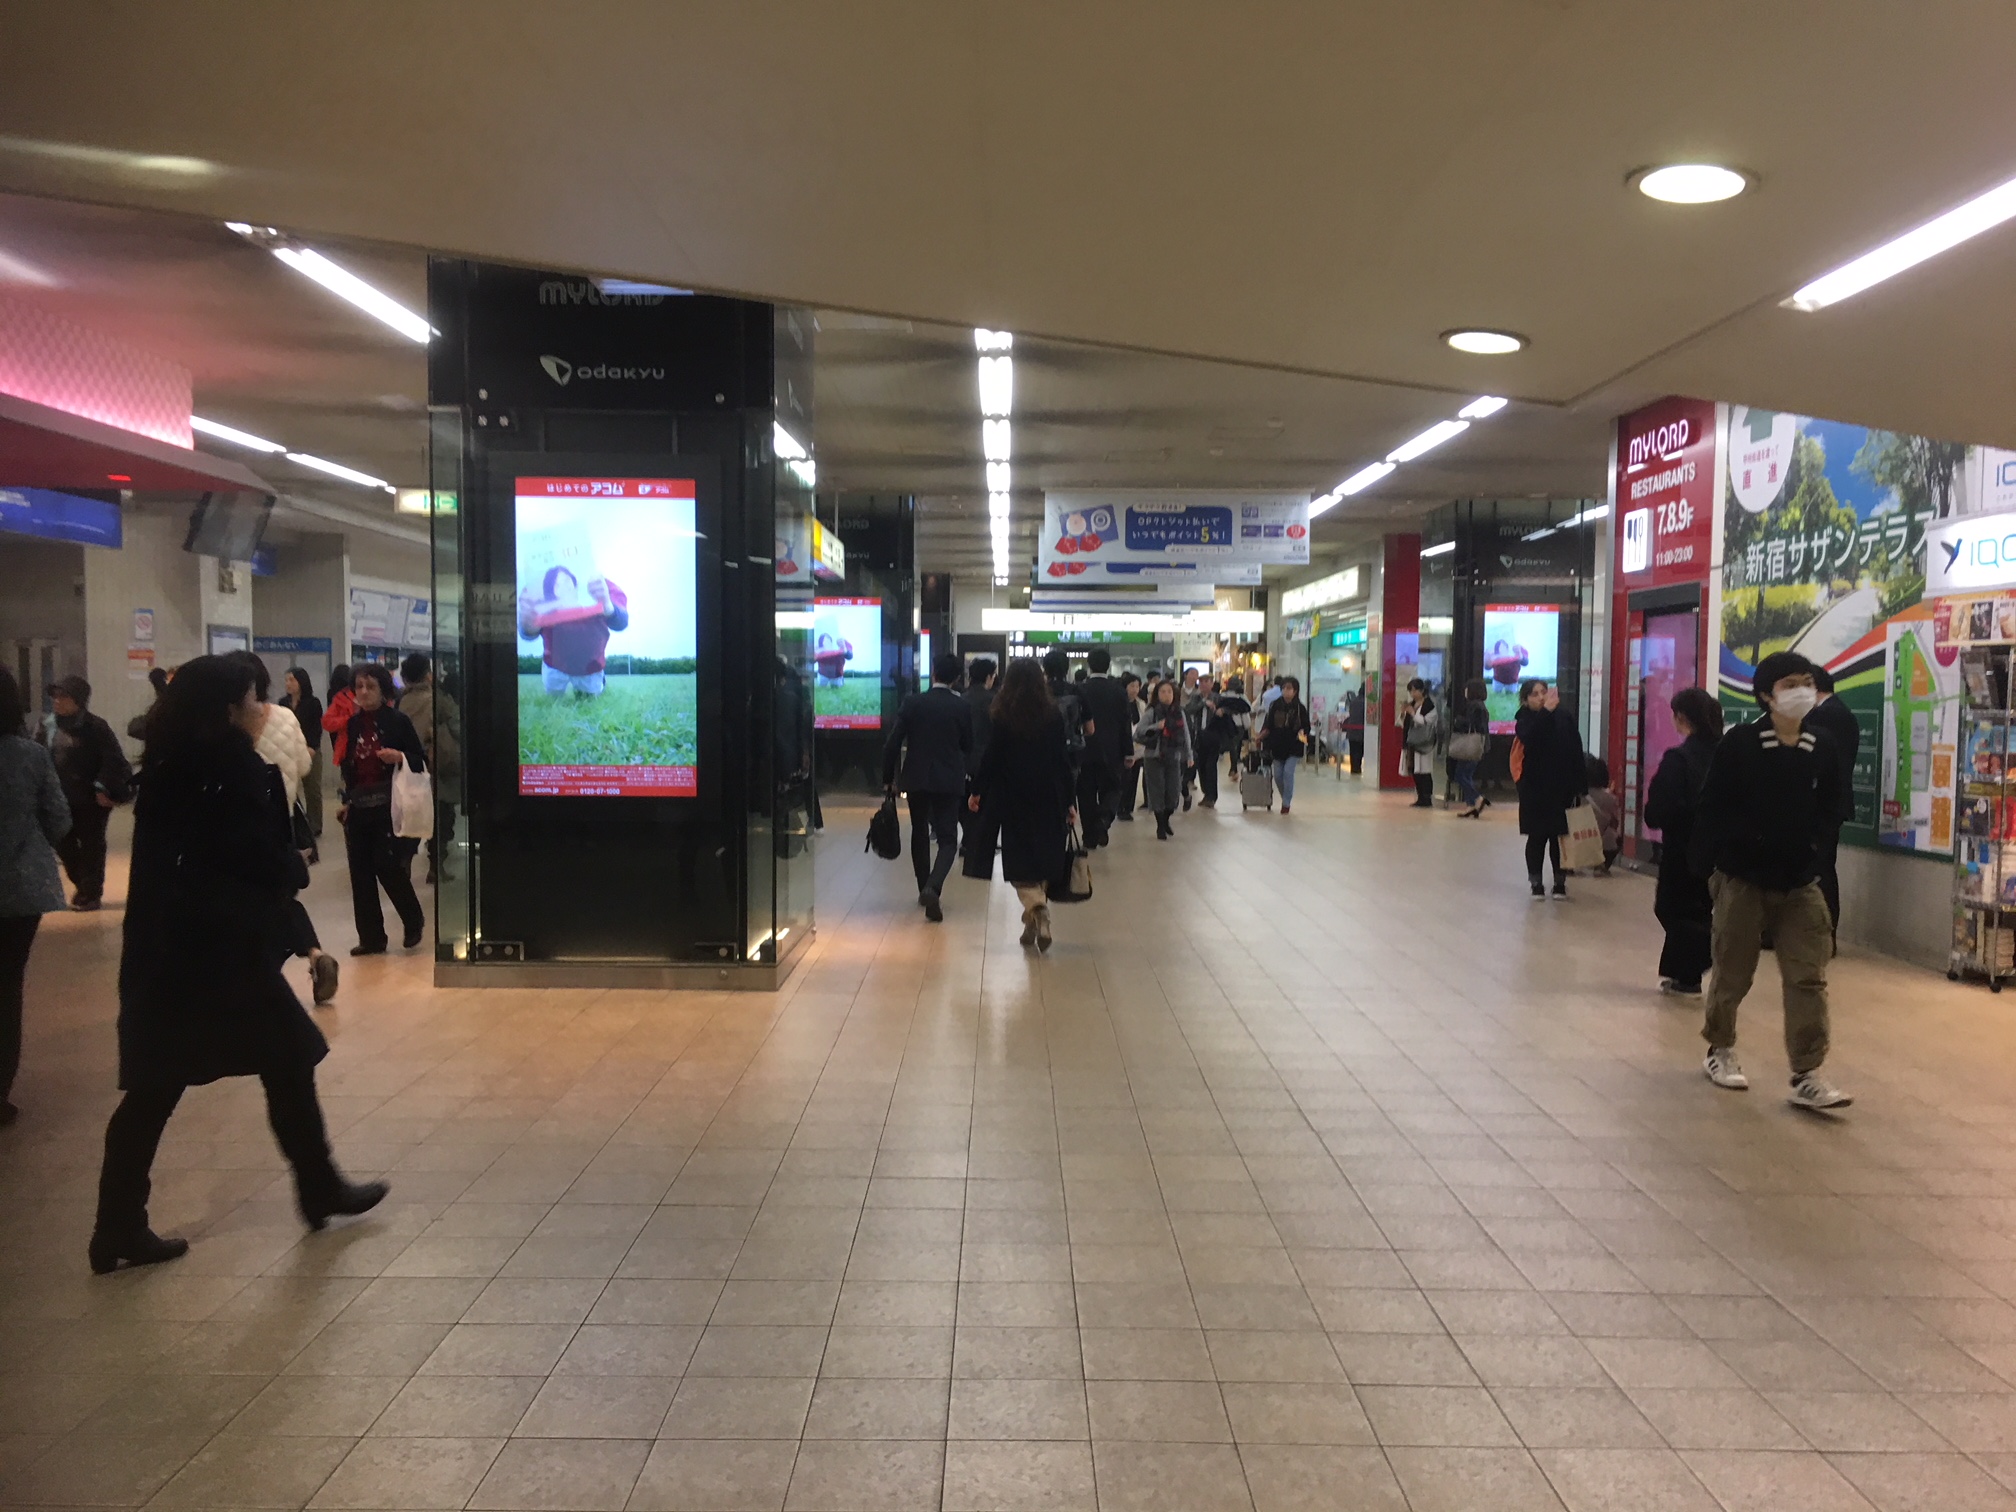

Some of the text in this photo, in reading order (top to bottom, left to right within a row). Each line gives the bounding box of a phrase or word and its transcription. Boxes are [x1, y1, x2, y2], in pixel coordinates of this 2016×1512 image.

[577, 363, 665, 379] odakyu
[1630, 419, 1688, 464] MYLORD
[1631, 462, 1696, 499] RESTAURANTS
[1657, 498, 1694, 535] 7.8.9F
[1656, 545, 1694, 567] 11:00-23:00
[1746, 509, 1936, 583] 新宿サザンテラス
